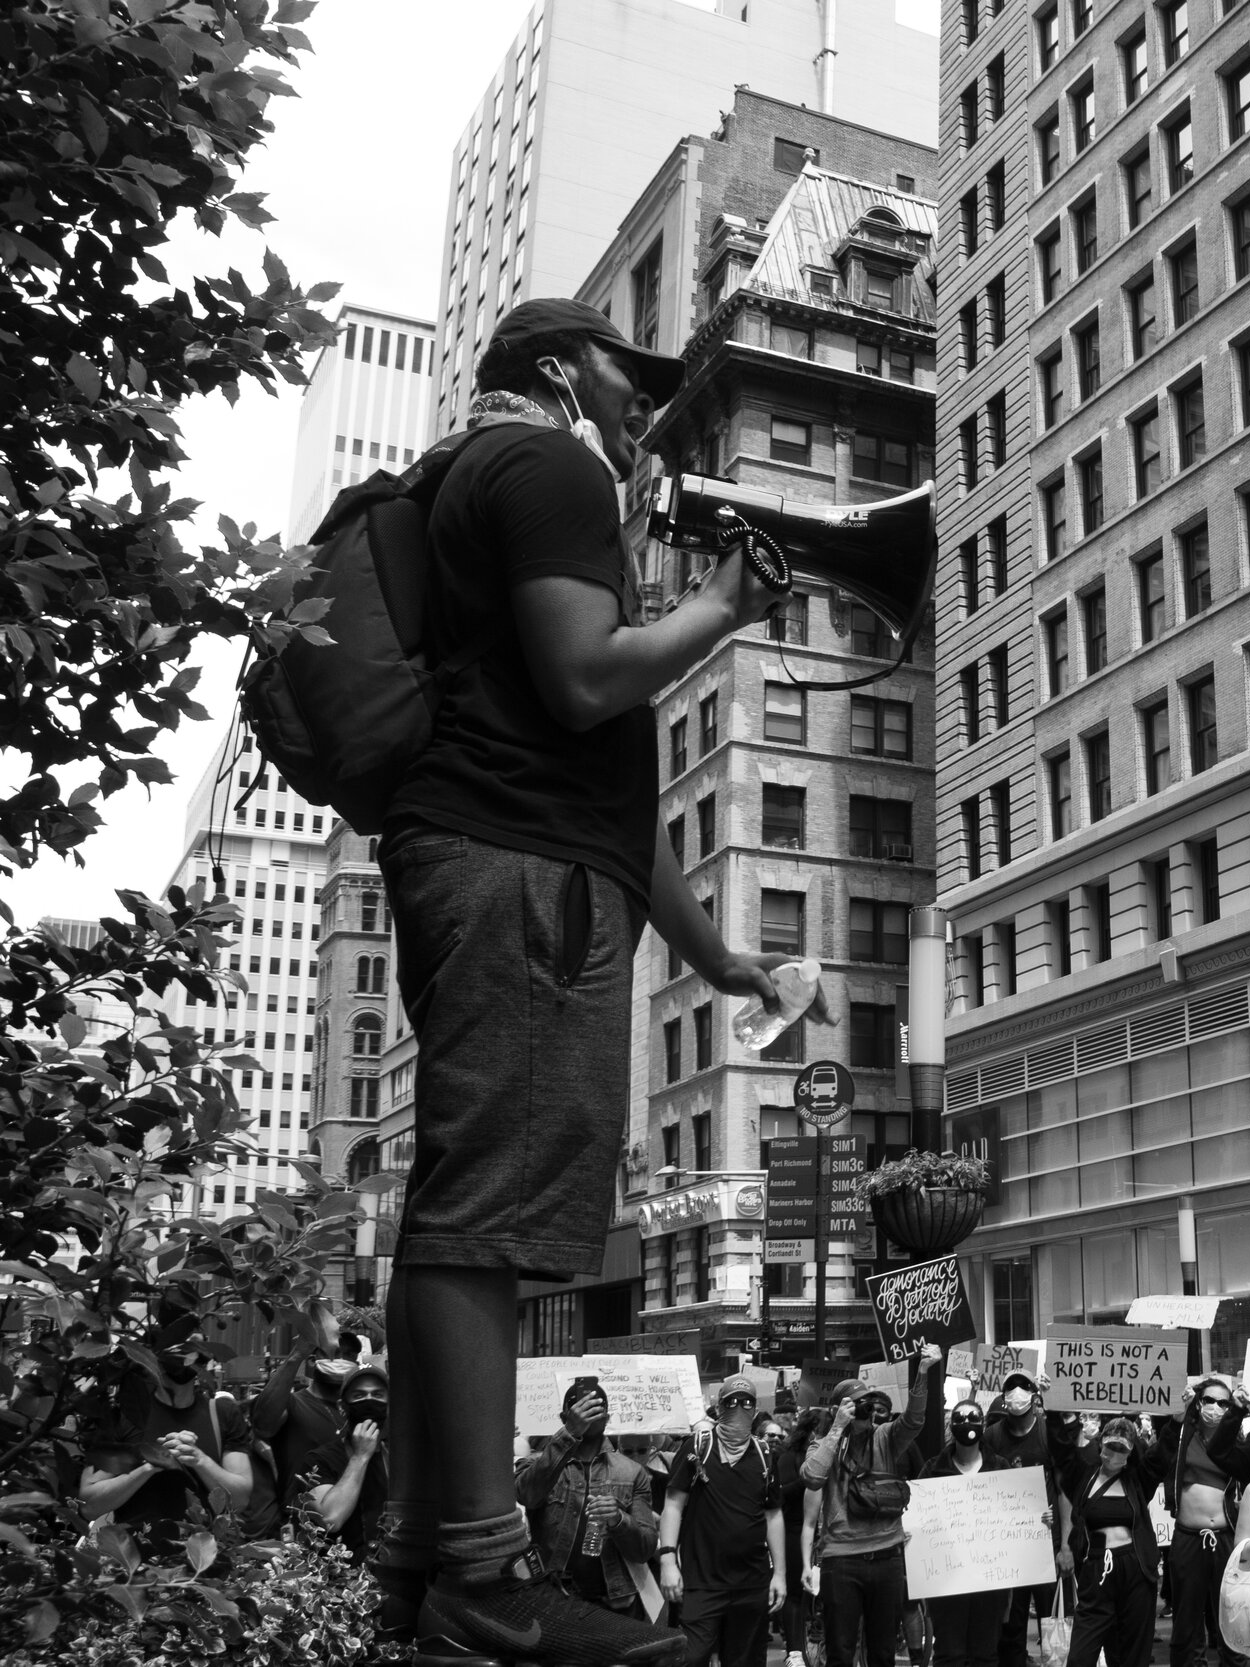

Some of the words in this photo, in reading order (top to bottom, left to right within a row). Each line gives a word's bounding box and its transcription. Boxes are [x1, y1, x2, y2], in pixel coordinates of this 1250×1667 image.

[898, 1022, 909, 1063] Marriott
[800, 1107, 811, 1119] NO
[812, 1106, 848, 1123] STANDING
[832, 1137, 857, 1152] SIM1
[770, 1160, 782, 1168] Port
[784, 1159, 812, 1167] Richmond
[832, 1158, 864, 1172] SIM3c
[769, 1179, 796, 1187] Annadale
[769, 1199, 793, 1207] Mariners
[831, 1198, 864, 1212] SIM33c
[768, 1219, 783, 1228] Drop
[784, 1218, 792, 1226] Off
[794, 1218, 807, 1227] Only
[830, 1218, 856, 1231] MTA
[768, 1241, 796, 1251] Broadway
[768, 1250, 793, 1258] Cortlandt
[876, 1259, 958, 1310] Ignorance
[630, 1333, 688, 1352] BLACK
[890, 1336, 926, 1360] BLM
[991, 1345, 1023, 1361] SAY
[1056, 1342, 1094, 1358] THIS
[1101, 1343, 1114, 1358] IS
[1121, 1344, 1153, 1360] NOT
[1157, 1348, 1169, 1361] A
[809, 1366, 855, 1378] SCIENTISTS
[983, 1359, 1024, 1376] THEIR
[1053, 1361, 1098, 1378] RIOT
[1110, 1362, 1139, 1379] ITS
[1150, 1365, 1163, 1381] A
[1070, 1381, 1170, 1407] REBELLION
[659, 1403, 672, 1412] TO
[917, 1485, 936, 1499] Say
[941, 1482, 960, 1494] their
[921, 1558, 941, 1582] We
[984, 1567, 1020, 1584] #BLM
